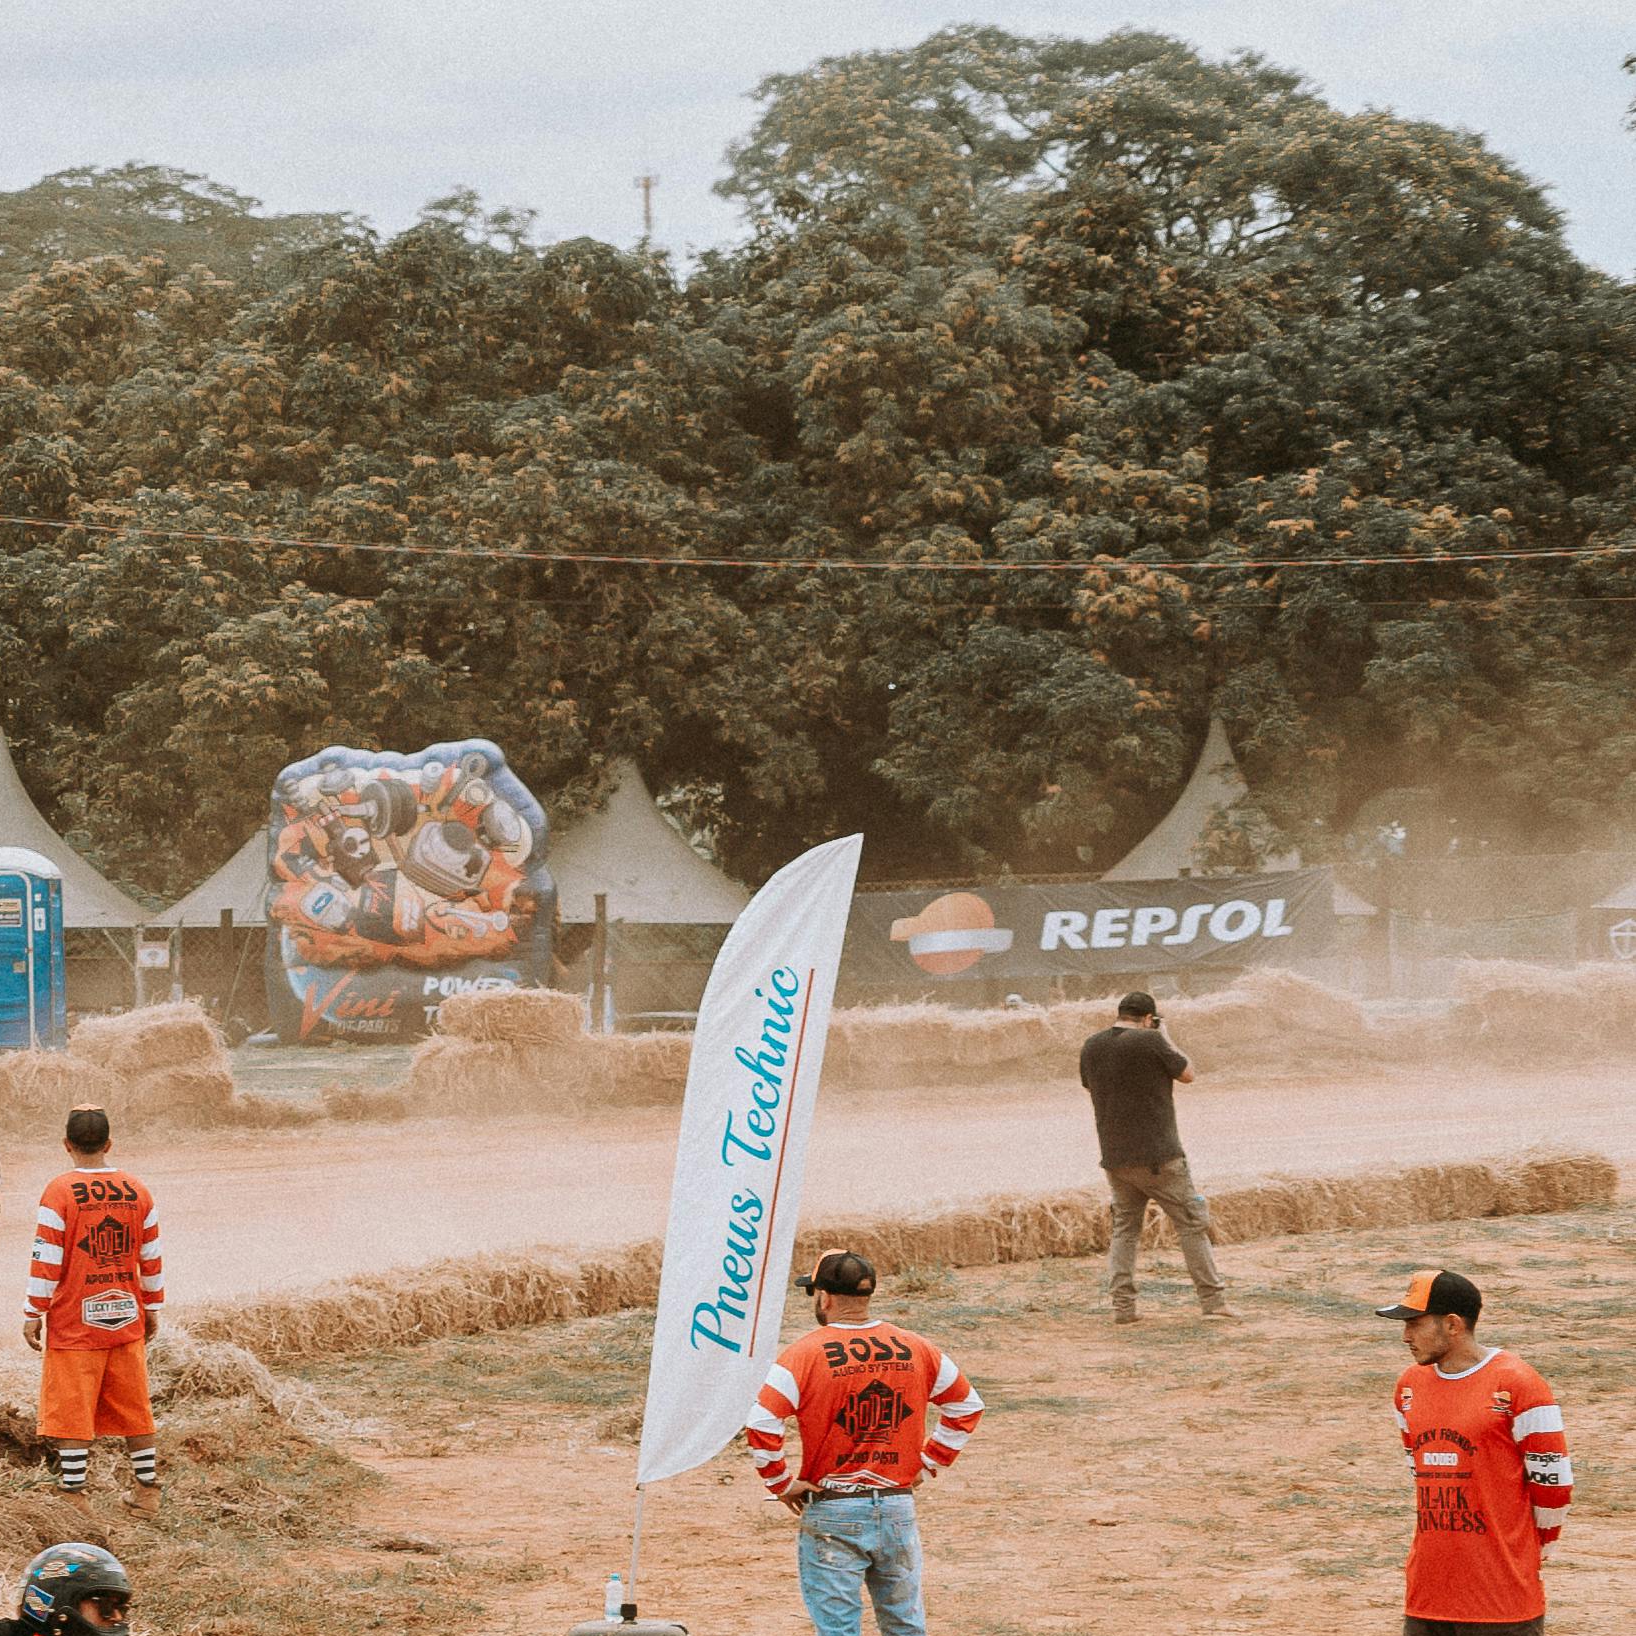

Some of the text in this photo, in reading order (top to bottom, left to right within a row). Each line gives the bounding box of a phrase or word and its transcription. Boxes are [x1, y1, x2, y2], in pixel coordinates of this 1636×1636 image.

[1040, 898, 1294, 951] REPSOL
[298, 968, 402, 1040] Vini
[690, 966, 799, 1354] Pneus Technic
[70, 1180, 138, 1204] BOSS
[822, 1335, 913, 1369] BOSS
[832, 1364, 866, 1378] AUDIO
